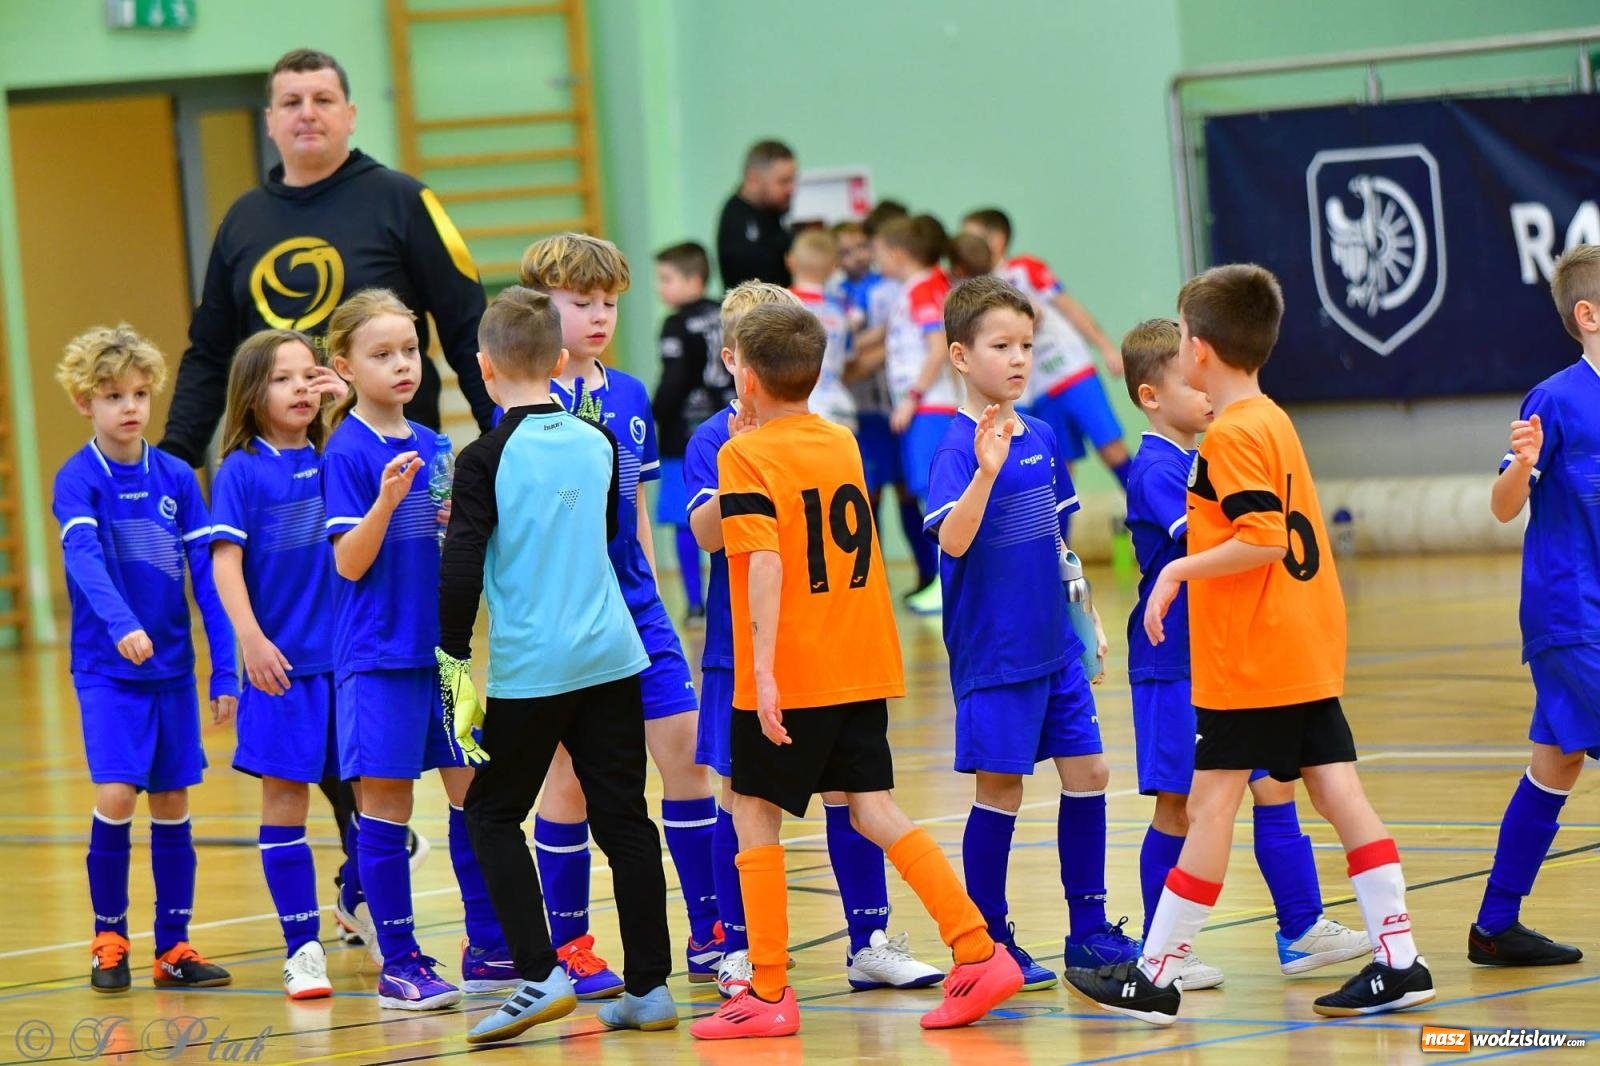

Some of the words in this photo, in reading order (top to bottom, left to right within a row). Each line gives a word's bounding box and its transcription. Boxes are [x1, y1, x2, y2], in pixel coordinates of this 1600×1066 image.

[1019, 453, 1043, 466] regio
[801, 483, 873, 594] 19
[161, 961, 184, 979] FILA
